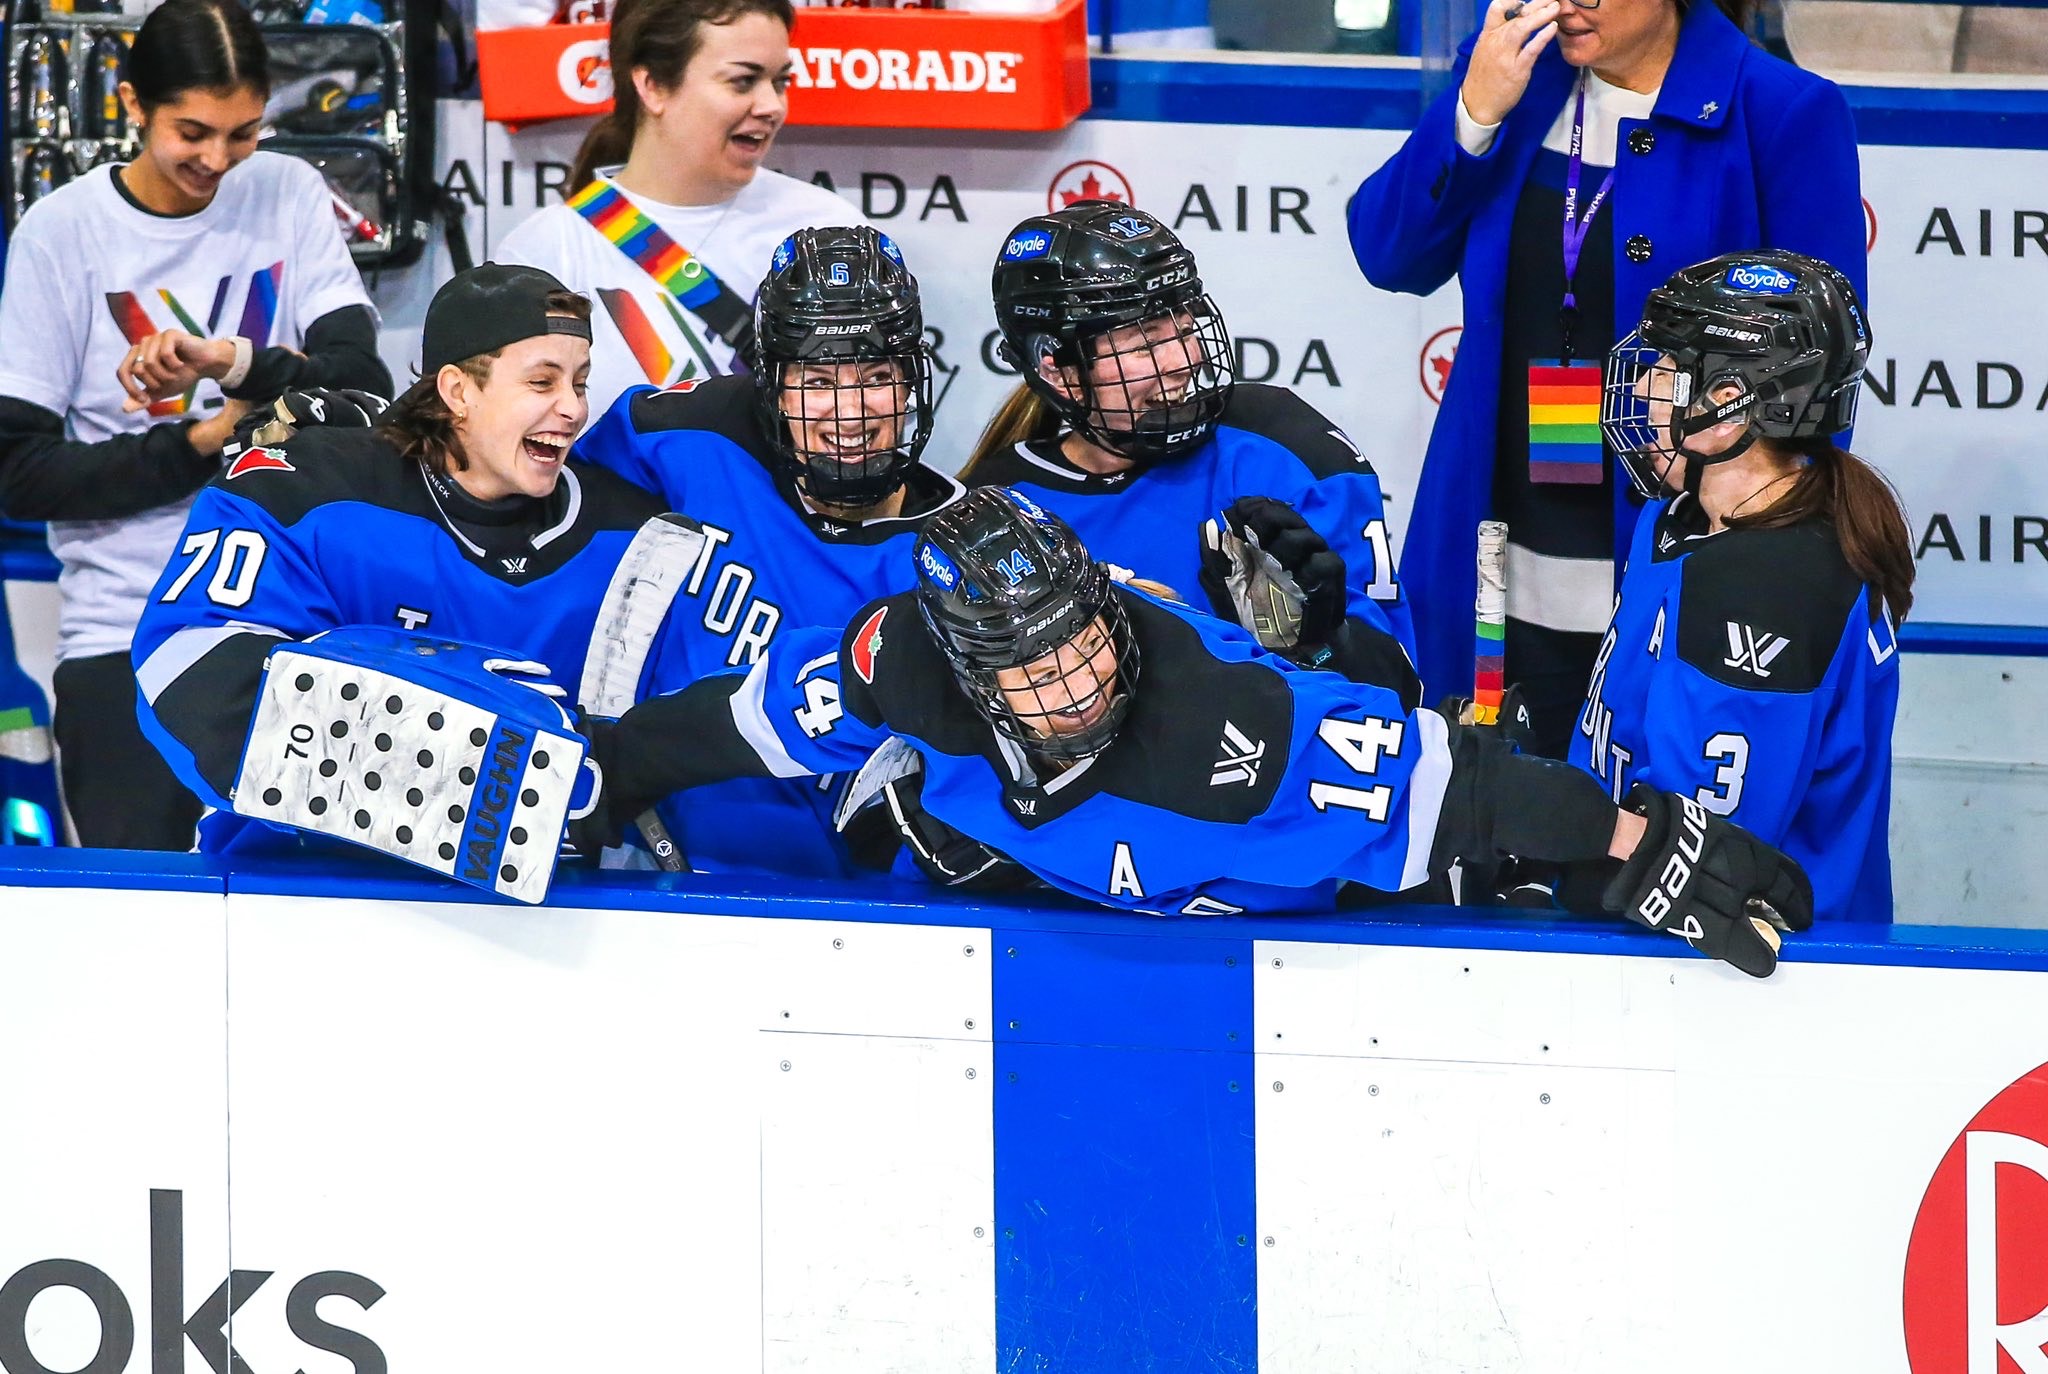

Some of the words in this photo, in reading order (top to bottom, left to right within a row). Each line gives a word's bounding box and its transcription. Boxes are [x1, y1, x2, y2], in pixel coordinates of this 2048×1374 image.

[787, 47, 1017, 93] ATORADE
[1109, 216, 1151, 239] 12
[1173, 183, 1317, 235] AIR
[1914, 207, 2048, 258] AIR
[1005, 235, 1046, 258] Royale
[830, 262, 850, 286] 6
[1146, 266, 1189, 291] CCM
[1731, 267, 1791, 290] Royale
[1014, 304, 1051, 318] CCM
[1915, 513, 2048, 563] AIR
[160, 528, 267, 607] 70
[920, 545, 955, 587] Royale
[995, 548, 1036, 588] 14
[1648, 605, 1666, 661] A
[284, 723, 314, 760] 70
[1309, 716, 1404, 822] 14
[1697, 733, 1750, 816] 3
[463, 727, 526, 881] VAUGHN
[1109, 842, 1144, 897] A
[1638, 792, 1708, 928] BAUE
